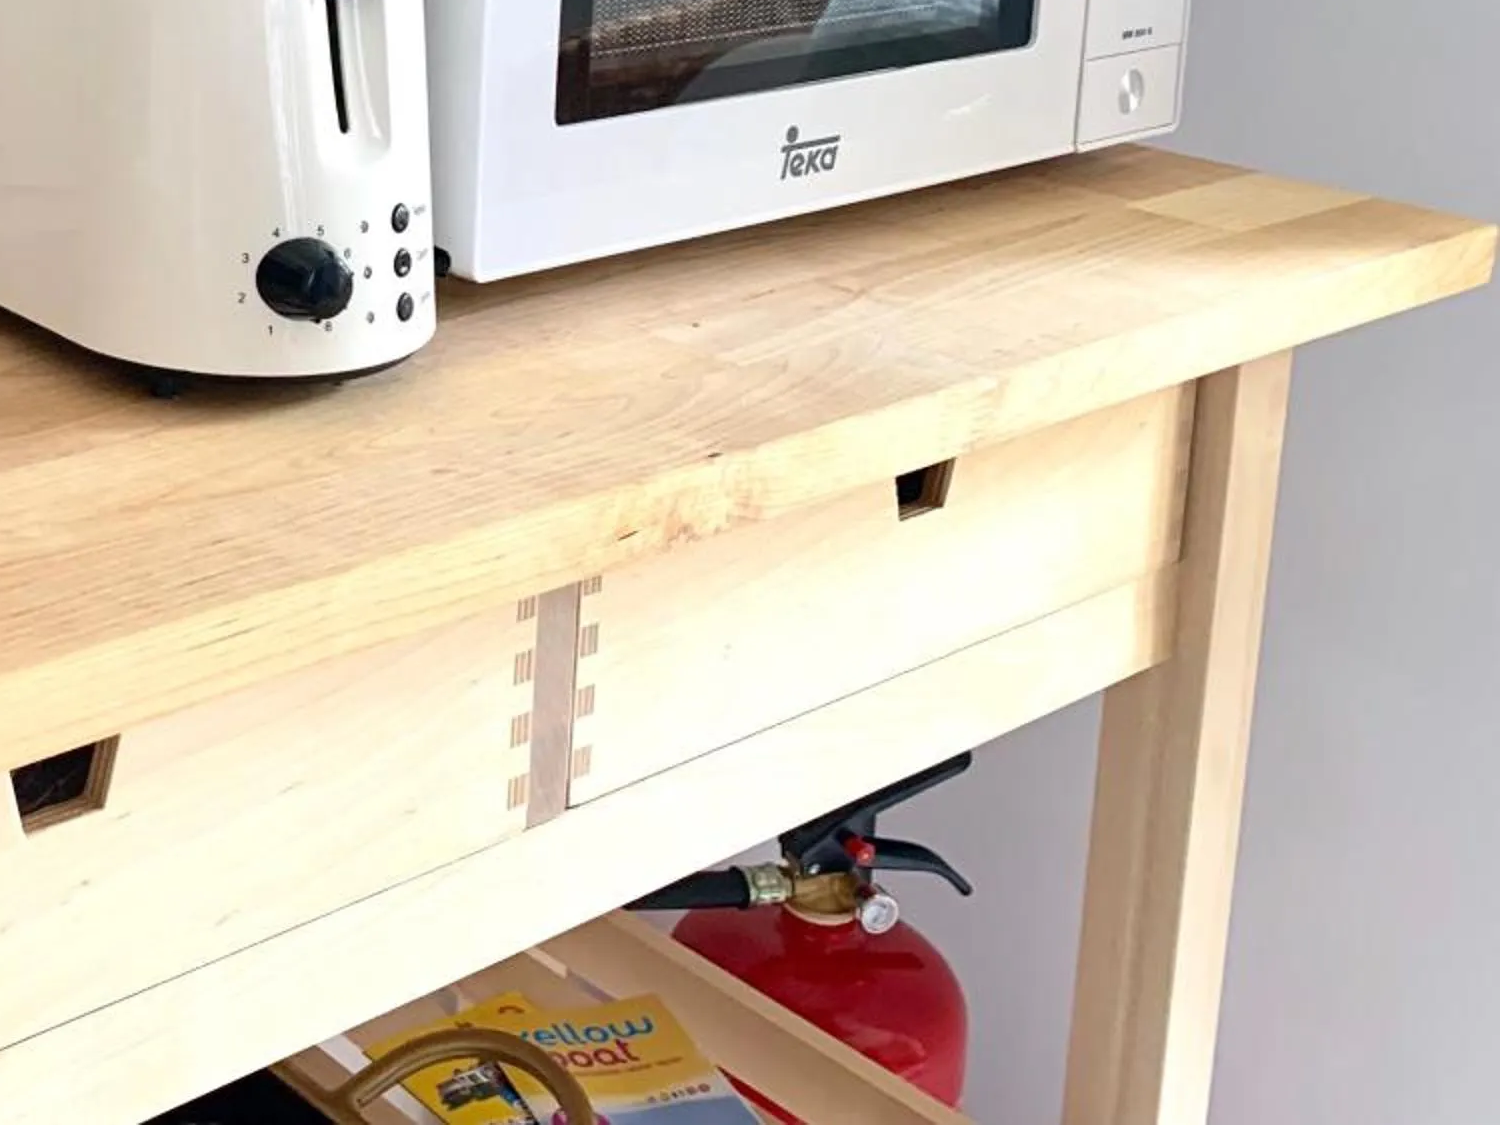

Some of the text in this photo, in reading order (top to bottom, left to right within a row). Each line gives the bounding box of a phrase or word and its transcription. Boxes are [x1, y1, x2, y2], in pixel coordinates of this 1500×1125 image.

[272, 227, 280, 237] 4
[317, 225, 325, 236] 5
[242, 253, 249, 263] 3
[238, 292, 246, 303] 2
[520, 1015, 653, 1046] ellow
